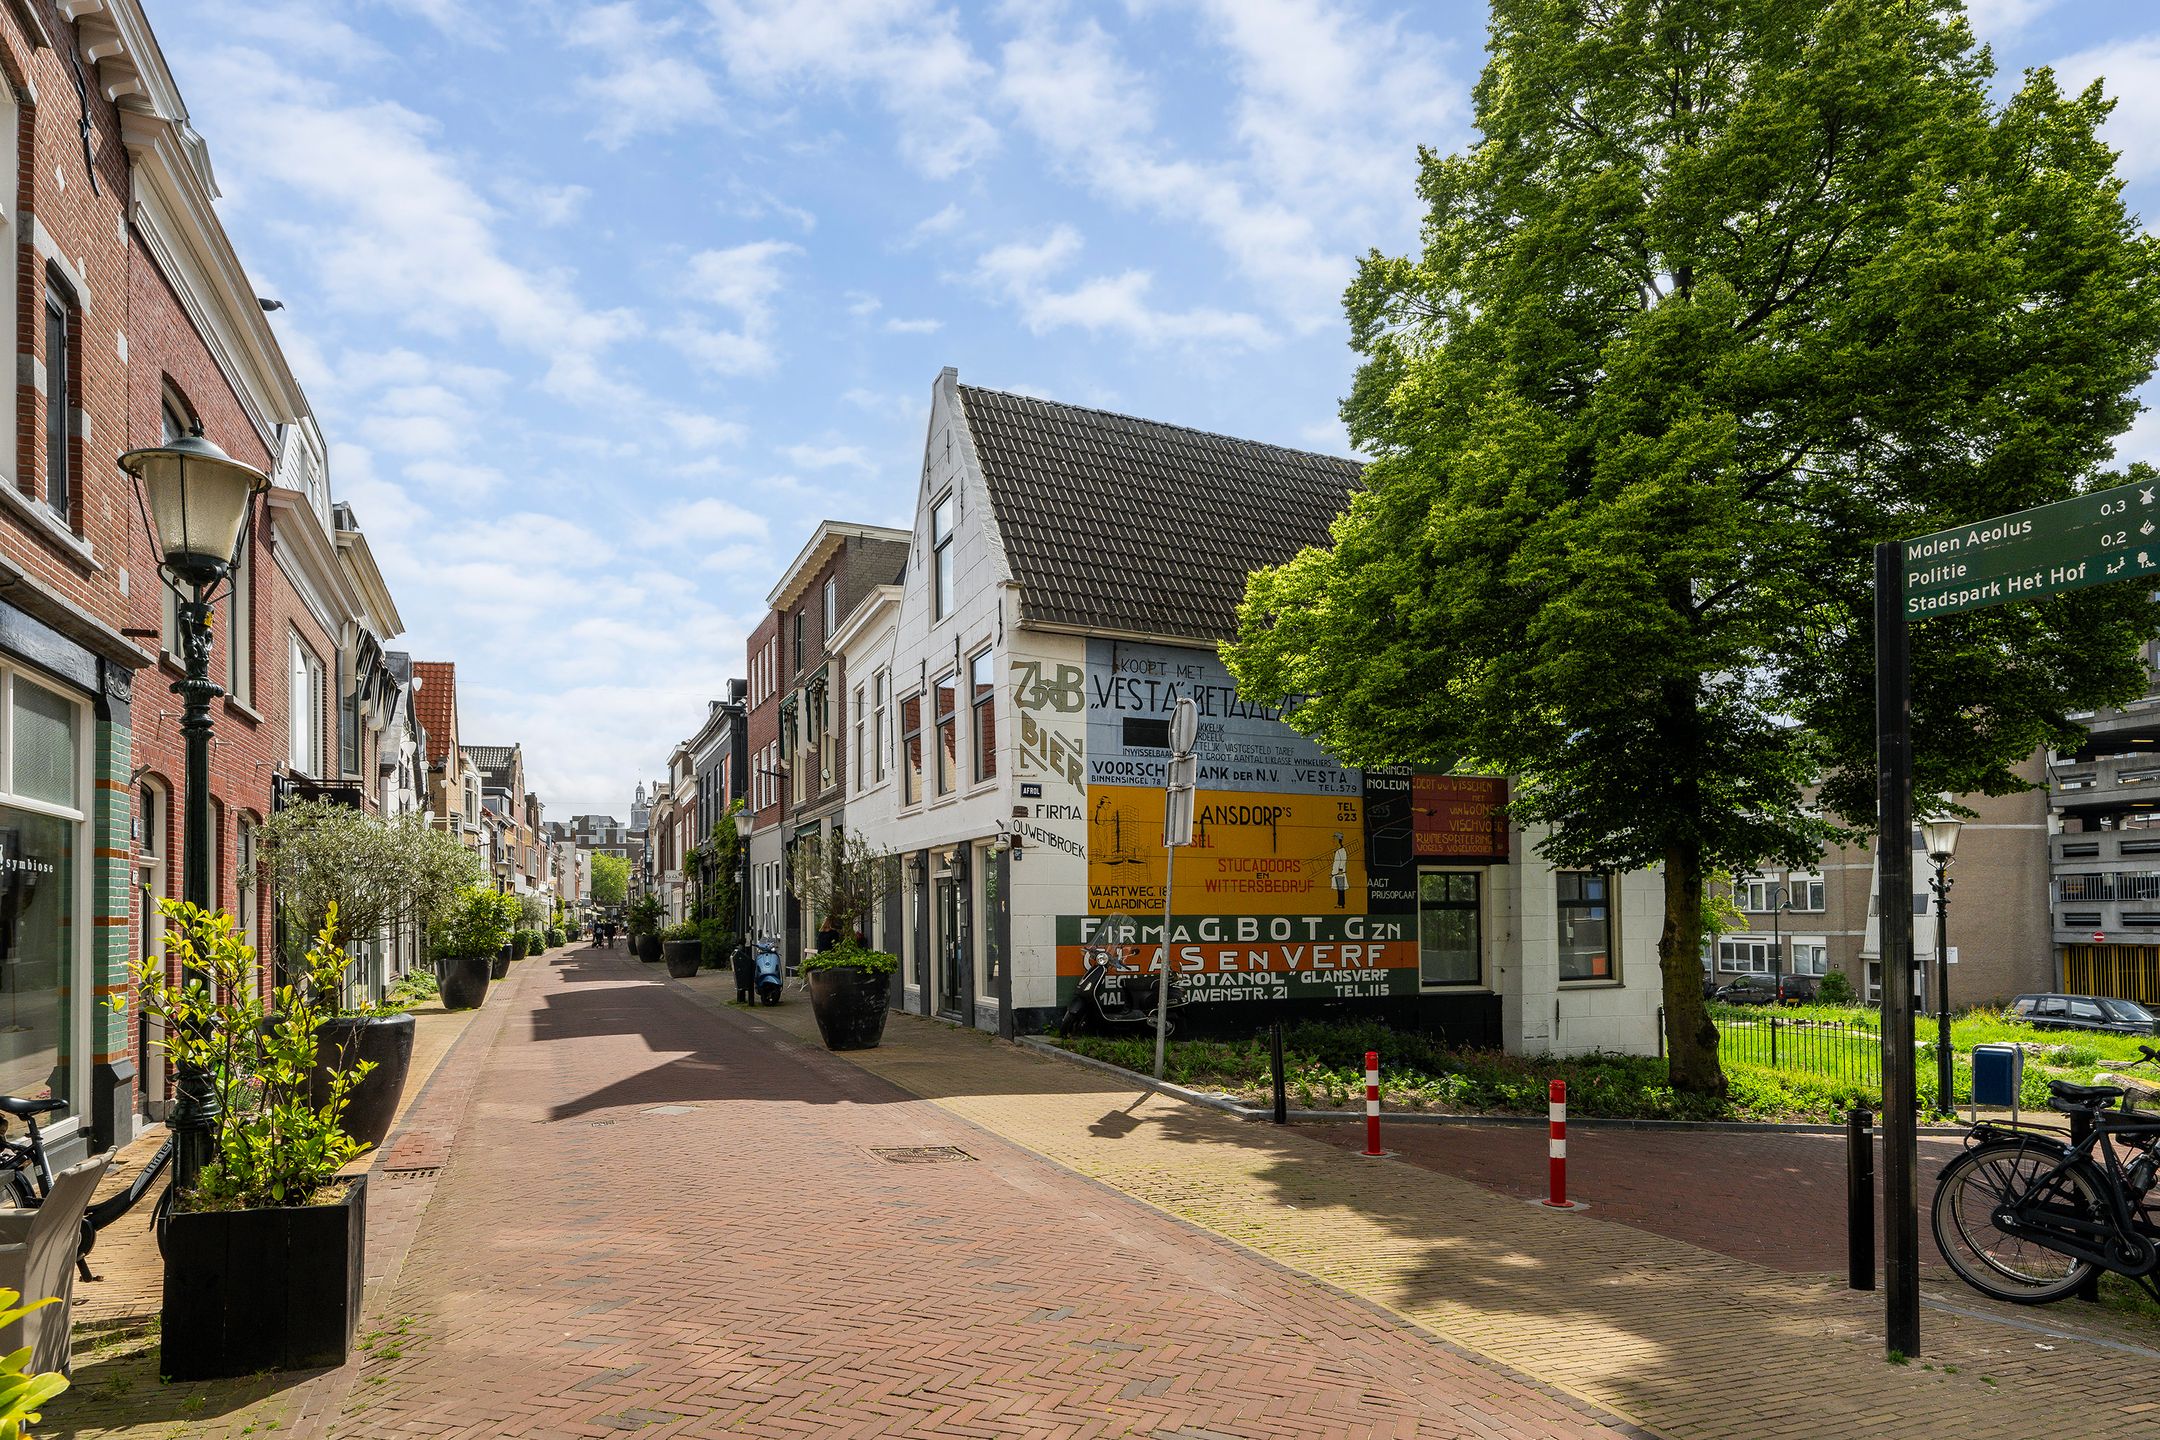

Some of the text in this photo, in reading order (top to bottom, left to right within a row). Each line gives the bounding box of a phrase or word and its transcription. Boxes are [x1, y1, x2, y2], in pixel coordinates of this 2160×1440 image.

[1908, 537, 1960, 560] Molen
[1967, 520, 2033, 547] Aeolus
[1908, 563, 1967, 588] Politie
[1908, 562, 2086, 612] Stadspark Het Hof
[1120, 658, 1205, 679] KOOPT MET
[1021, 710, 1086, 797] BIER
[1225, 743, 1271, 755] VASTGESTELD
[1206, 752, 1231, 762] GROOT
[1233, 754, 1263, 764] AANTAL
[1091, 774, 1161, 786] BINNENSINGEL 78
[1233, 771, 1252, 781] DER
[1256, 769, 1280, 783] N.V.
[1450, 778, 1493, 793] VISSCHEN
[1036, 804, 1082, 820] FIRMA
[1337, 813, 1357, 822] 623
[6, 858, 54, 873] symbiose
[1218, 858, 1301, 873] STUCADOORS
[1256, 872, 1270, 880] EN
[1090, 886, 1156, 897] VAARTWEG.
[1205, 879, 1314, 893] WITTERSBEDRIJF
[1090, 898, 1167, 909] VLAARDINGEN
[1080, 918, 1192, 944] FIRMA
[1198, 917, 1229, 943] G.
[1219, 951, 1269, 971] EN
[1280, 945, 1386, 969] VERF
[1300, 969, 1390, 984] GLANSVERF
[1272, 986, 1289, 1000] 21
